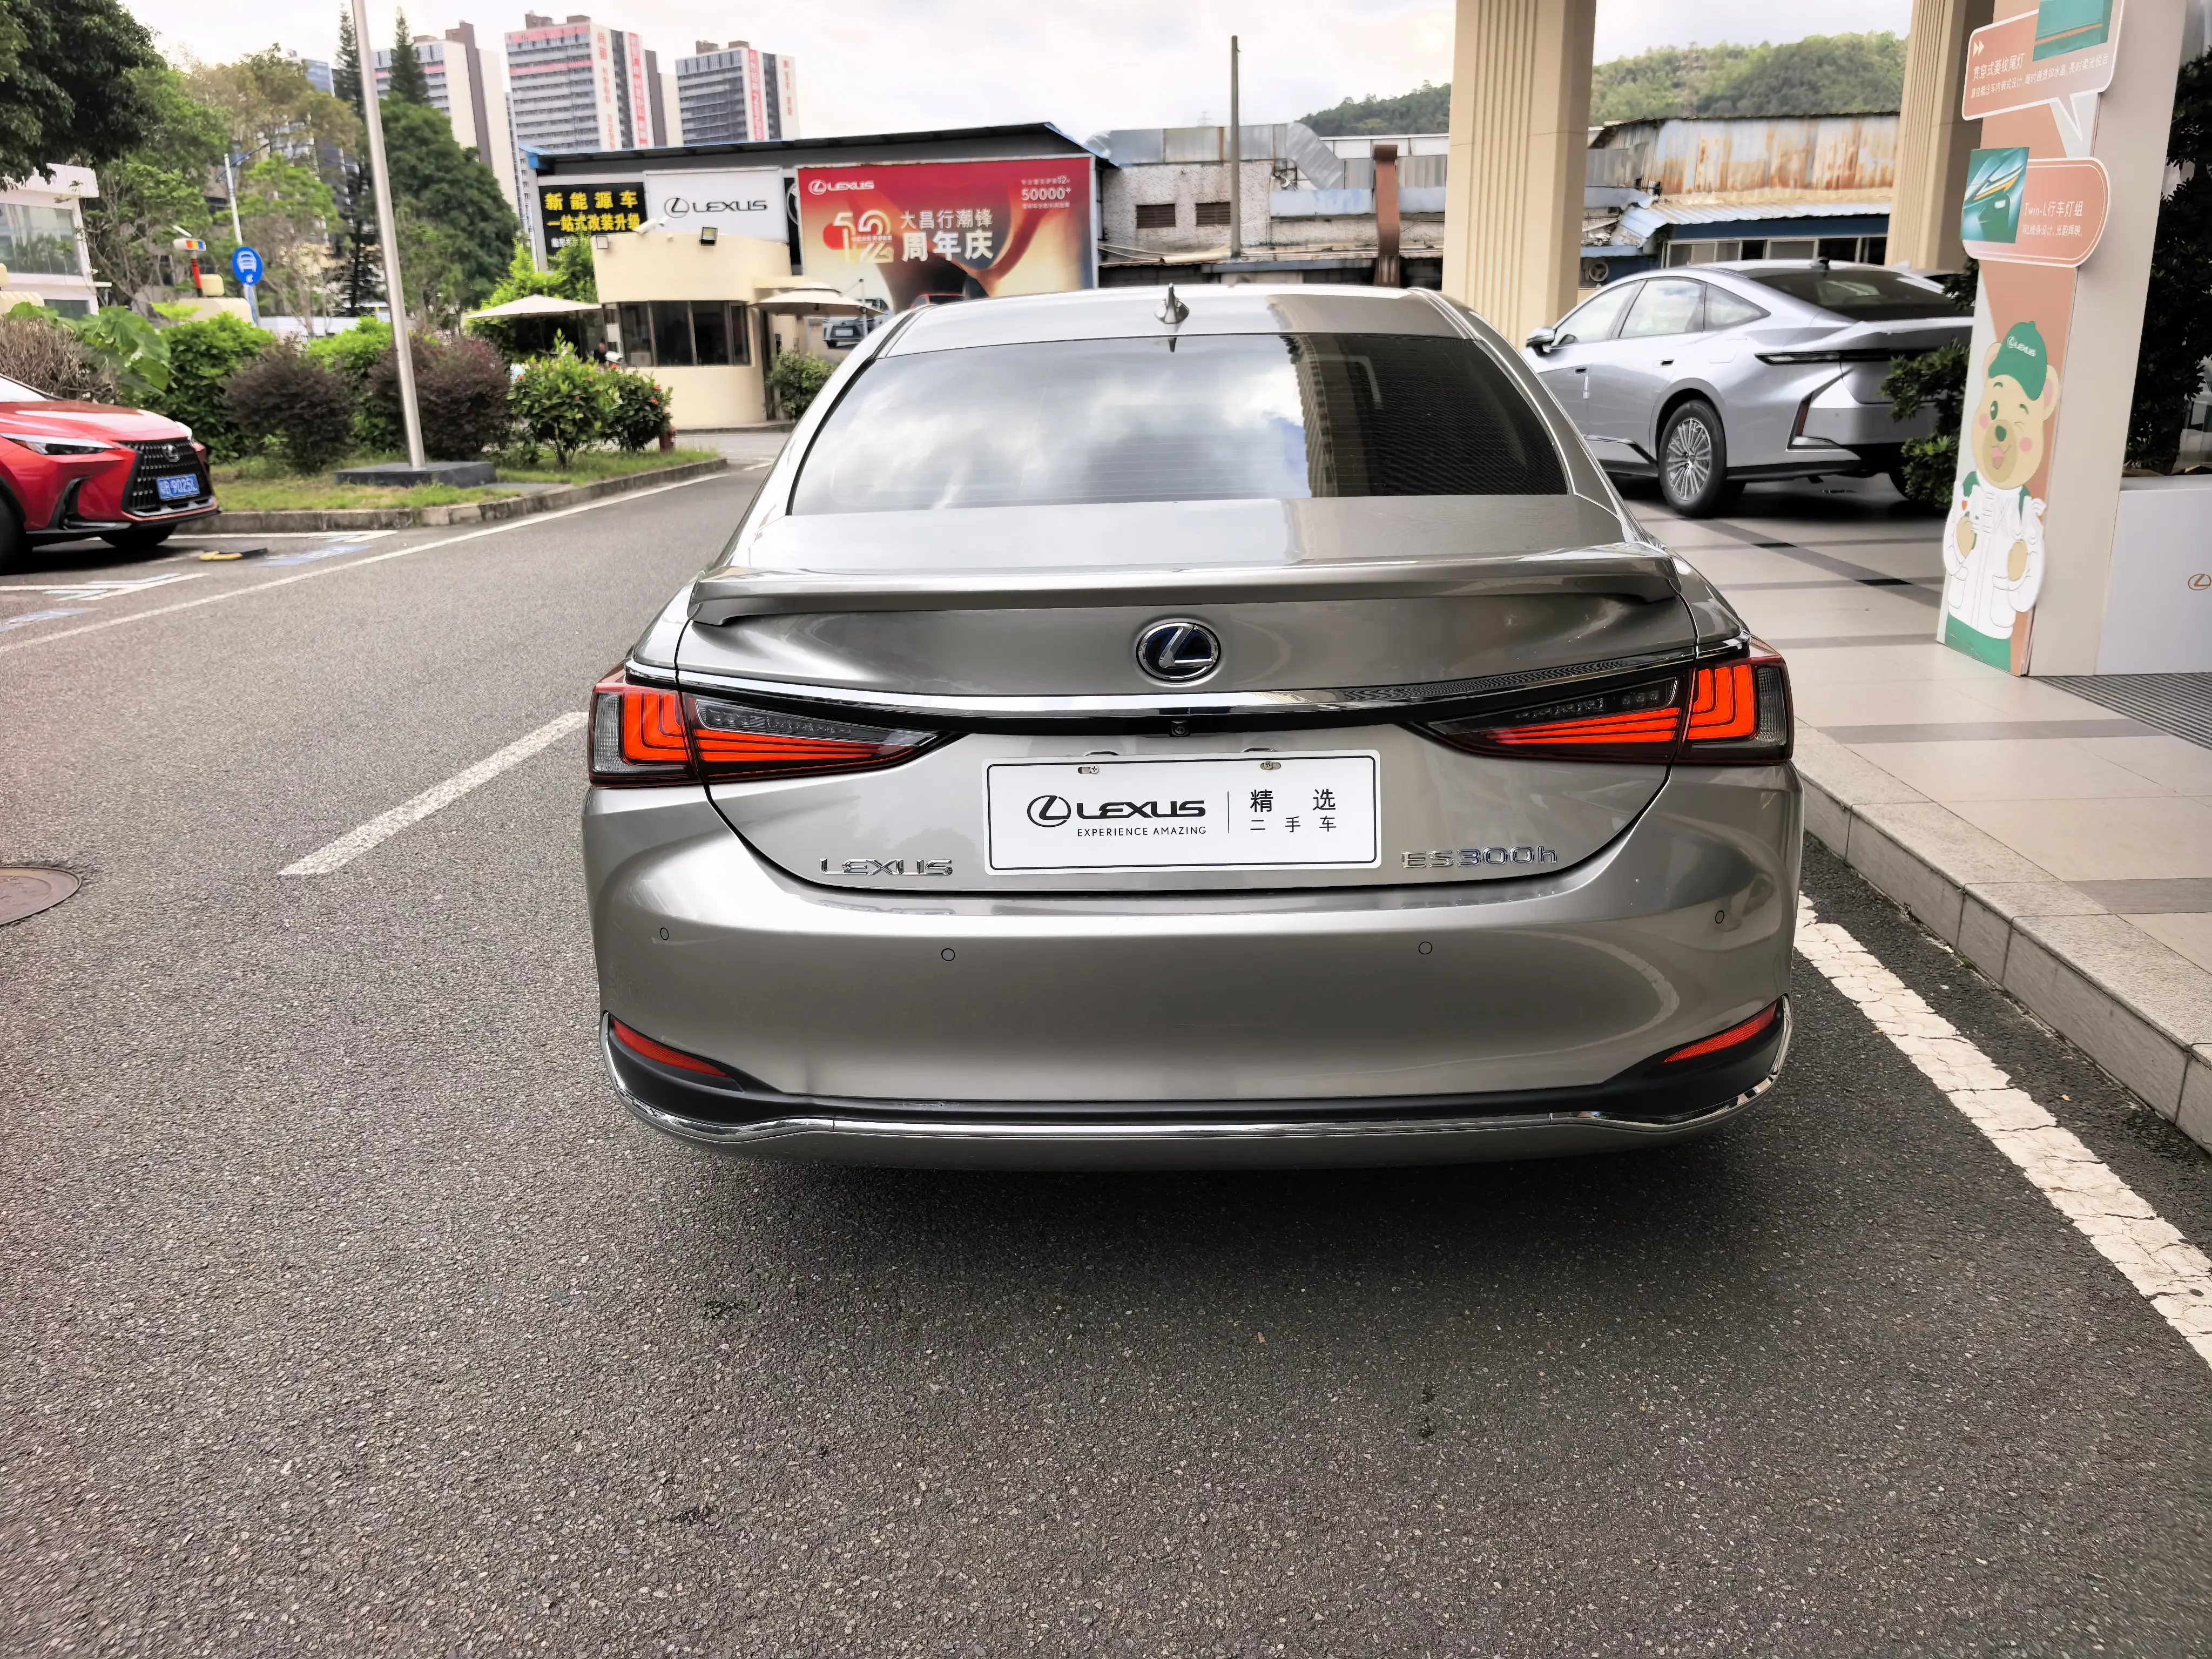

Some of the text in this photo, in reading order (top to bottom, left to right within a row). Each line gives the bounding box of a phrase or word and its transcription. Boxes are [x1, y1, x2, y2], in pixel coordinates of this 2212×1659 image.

[827, 180, 875, 191] LEXUS
[544, 190, 638, 211] 新能源车
[692, 200, 768, 213] LEXUS
[547, 212, 640, 232] 一站式改装升级
[900, 208, 993, 230] 大昌行潮锋
[901, 229, 994, 262] 周年庆
[2014, 341, 2036, 356] LEXUS
[1250, 788, 1336, 812] 精选
[1076, 800, 1206, 819] LEXUS
[1077, 826, 1206, 837] EXPERIENCE AMAZING
[1250, 815, 1337, 832] 二手车
[819, 858, 953, 876] LEXUS
